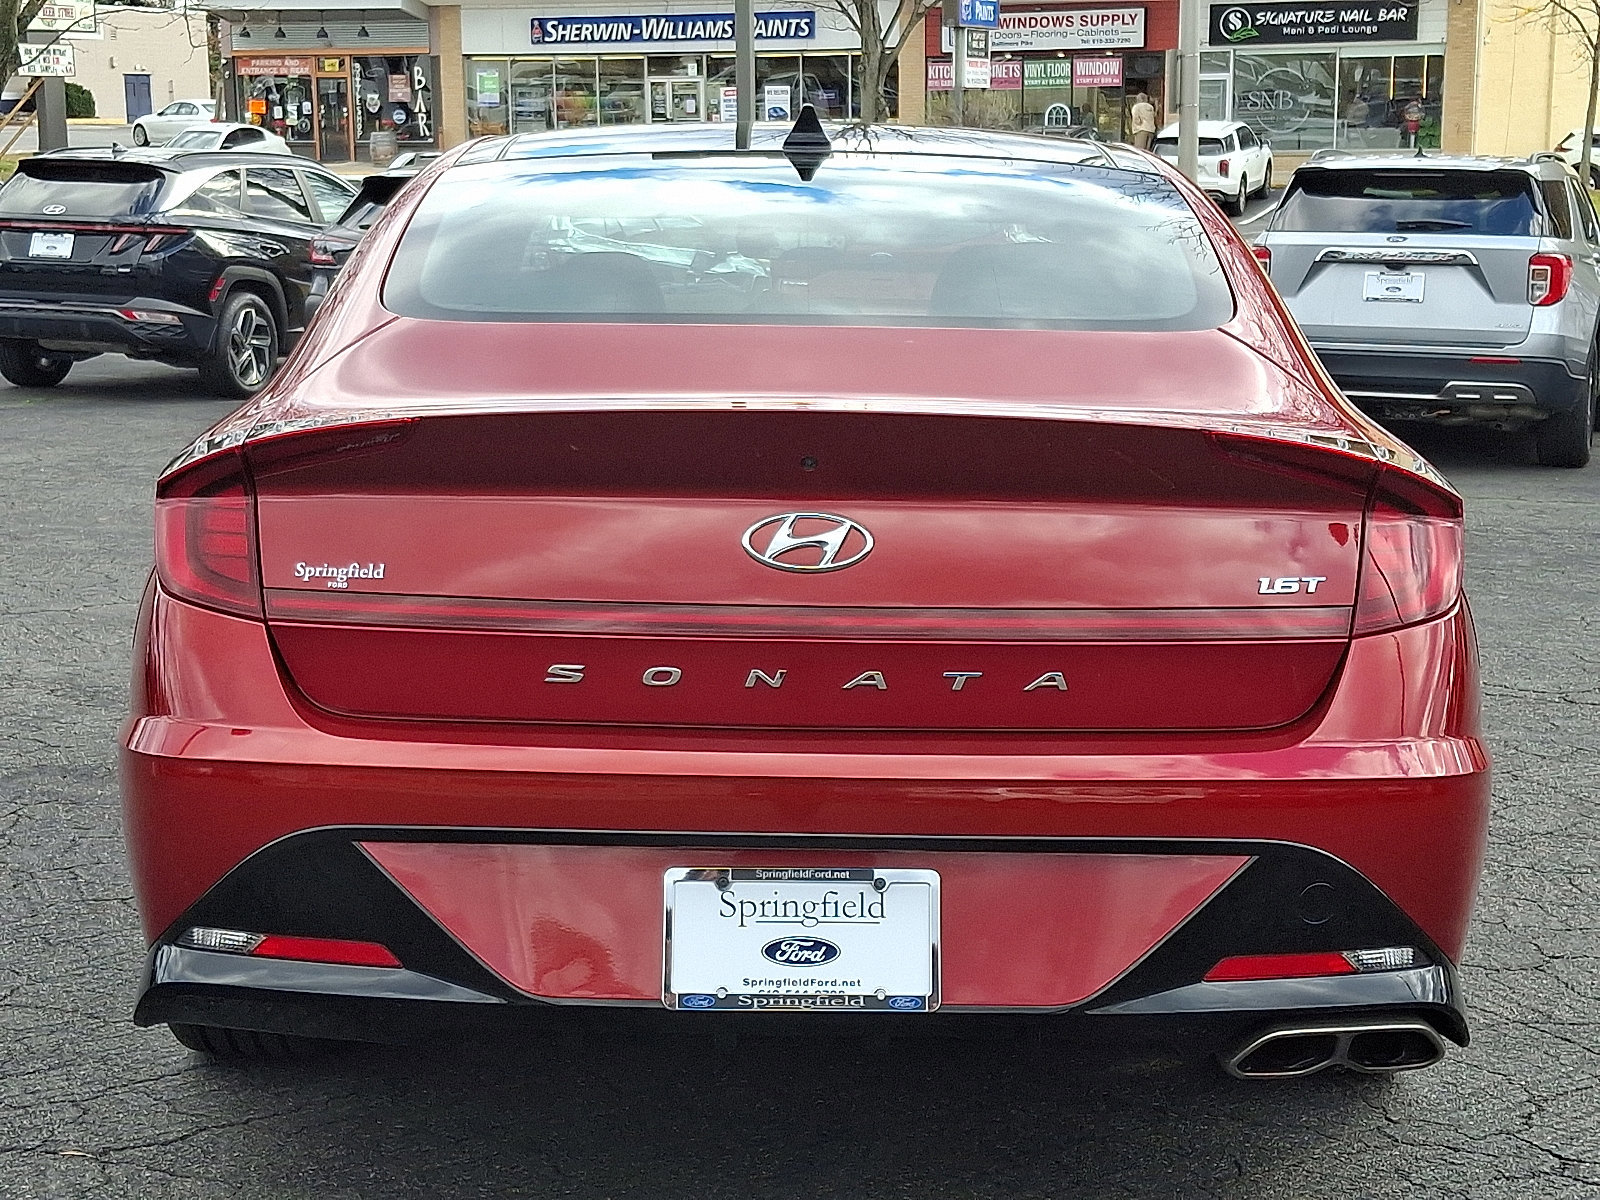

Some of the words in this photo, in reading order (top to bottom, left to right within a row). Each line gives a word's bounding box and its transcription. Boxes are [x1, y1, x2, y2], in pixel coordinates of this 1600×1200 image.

[1000, 15, 1075, 30] WINDOWS
[1079, 13, 1138, 27] SUPPLY
[1255, 10, 1336, 26] SIGNATURE
[1339, 9, 1373, 23] NAIL
[1378, 7, 1408, 22] BAR
[544, 17, 736, 42] SHERWIN-WILLIAMS
[991, 64, 1021, 79] INETS
[1024, 63, 1047, 79] VINYL
[1047, 62, 1071, 78] FLOOR
[1076, 61, 1120, 77] WINDOW
[413, 65, 431, 137] BAR
[1246, 90, 1294, 111] SNB
[294, 561, 386, 582] Springfield
[327, 581, 349, 589] FORD
[543, 663, 1069, 692] SONATA
[755, 868, 851, 880] SpringfieldFord.net
[718, 890, 887, 928] Springfield
[776, 938, 826, 963] Ford
[742, 977, 862, 988] SpringfieldFord.net
[737, 995, 866, 1010] Springfield
